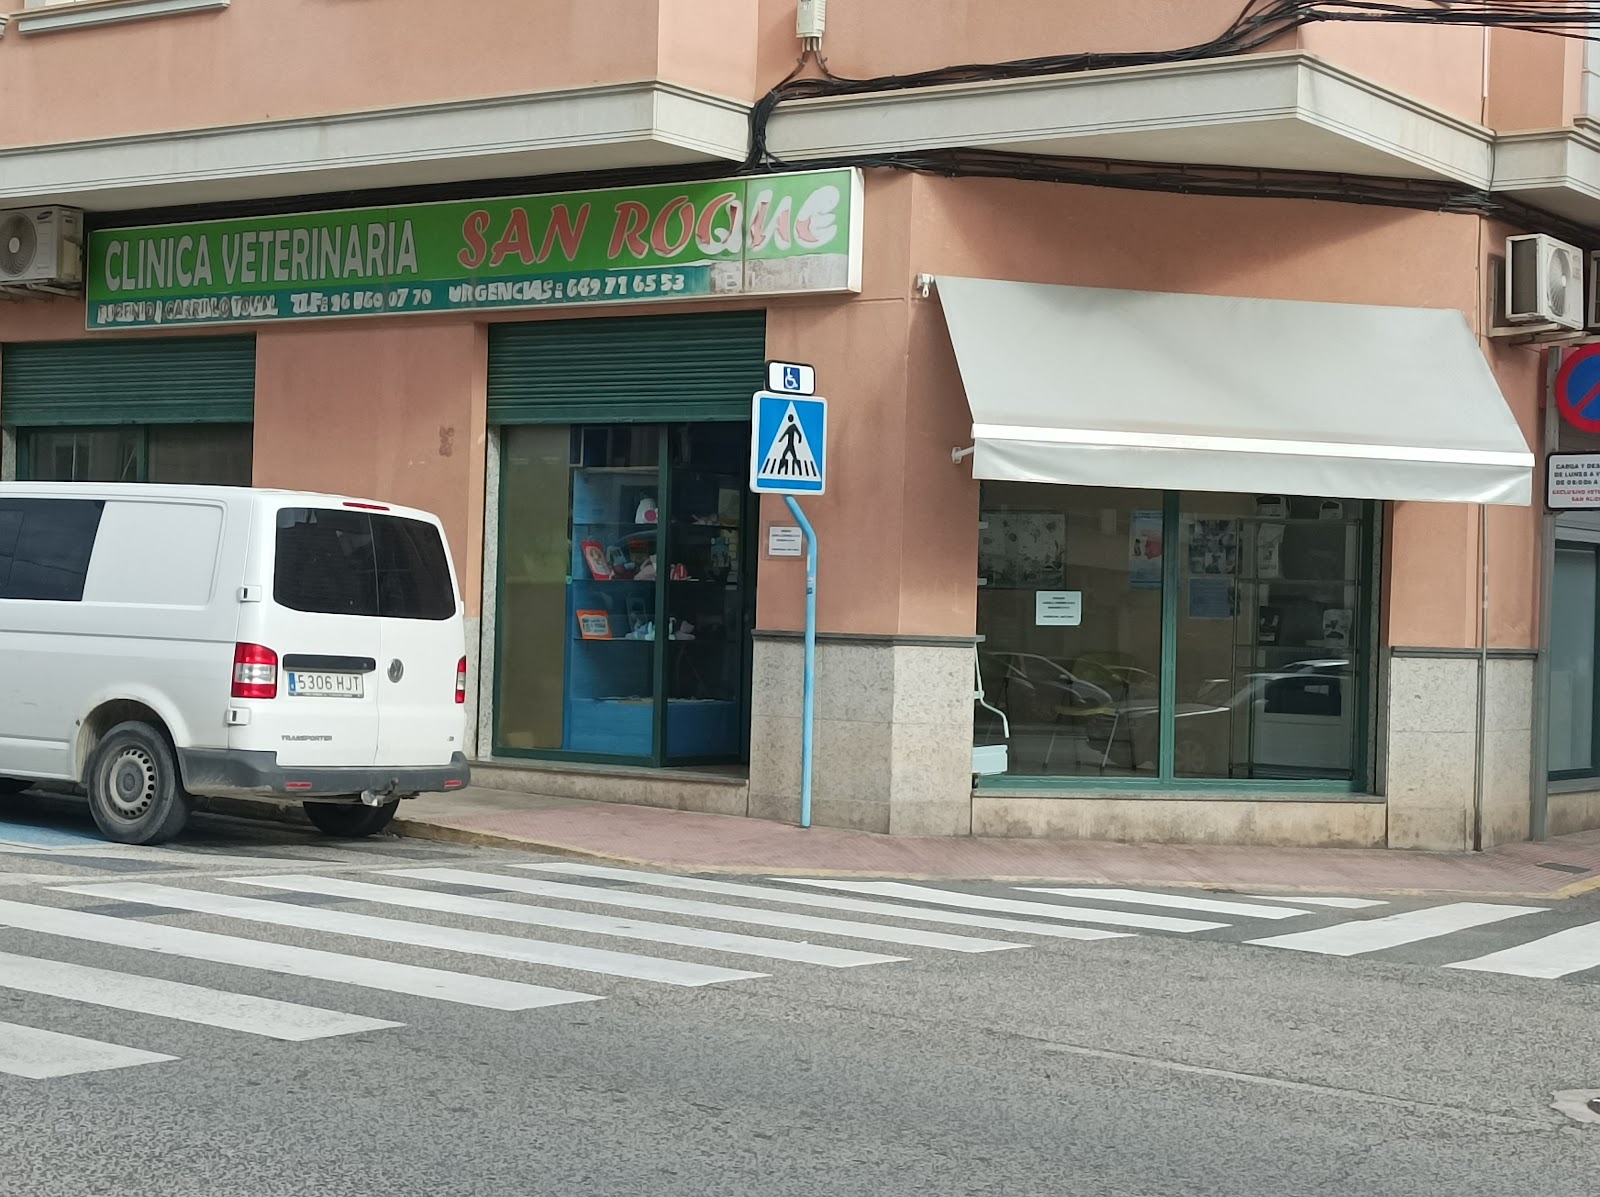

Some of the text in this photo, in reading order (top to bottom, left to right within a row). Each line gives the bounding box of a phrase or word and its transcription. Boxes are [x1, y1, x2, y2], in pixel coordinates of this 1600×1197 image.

[104, 219, 418, 292] CLINICA VETERINARIA
[457, 185, 840, 270] SAN ROQUE
[165, 296, 230, 320] CARRILLO
[388, 288, 409, 308] 07
[412, 289, 432, 305] 70
[566, 277, 601, 297] 649
[604, 275, 628, 295] 71
[632, 274, 656, 293] 65
[660, 273, 685, 291] 53
[298, 674, 360, 692] 5306 HJT
